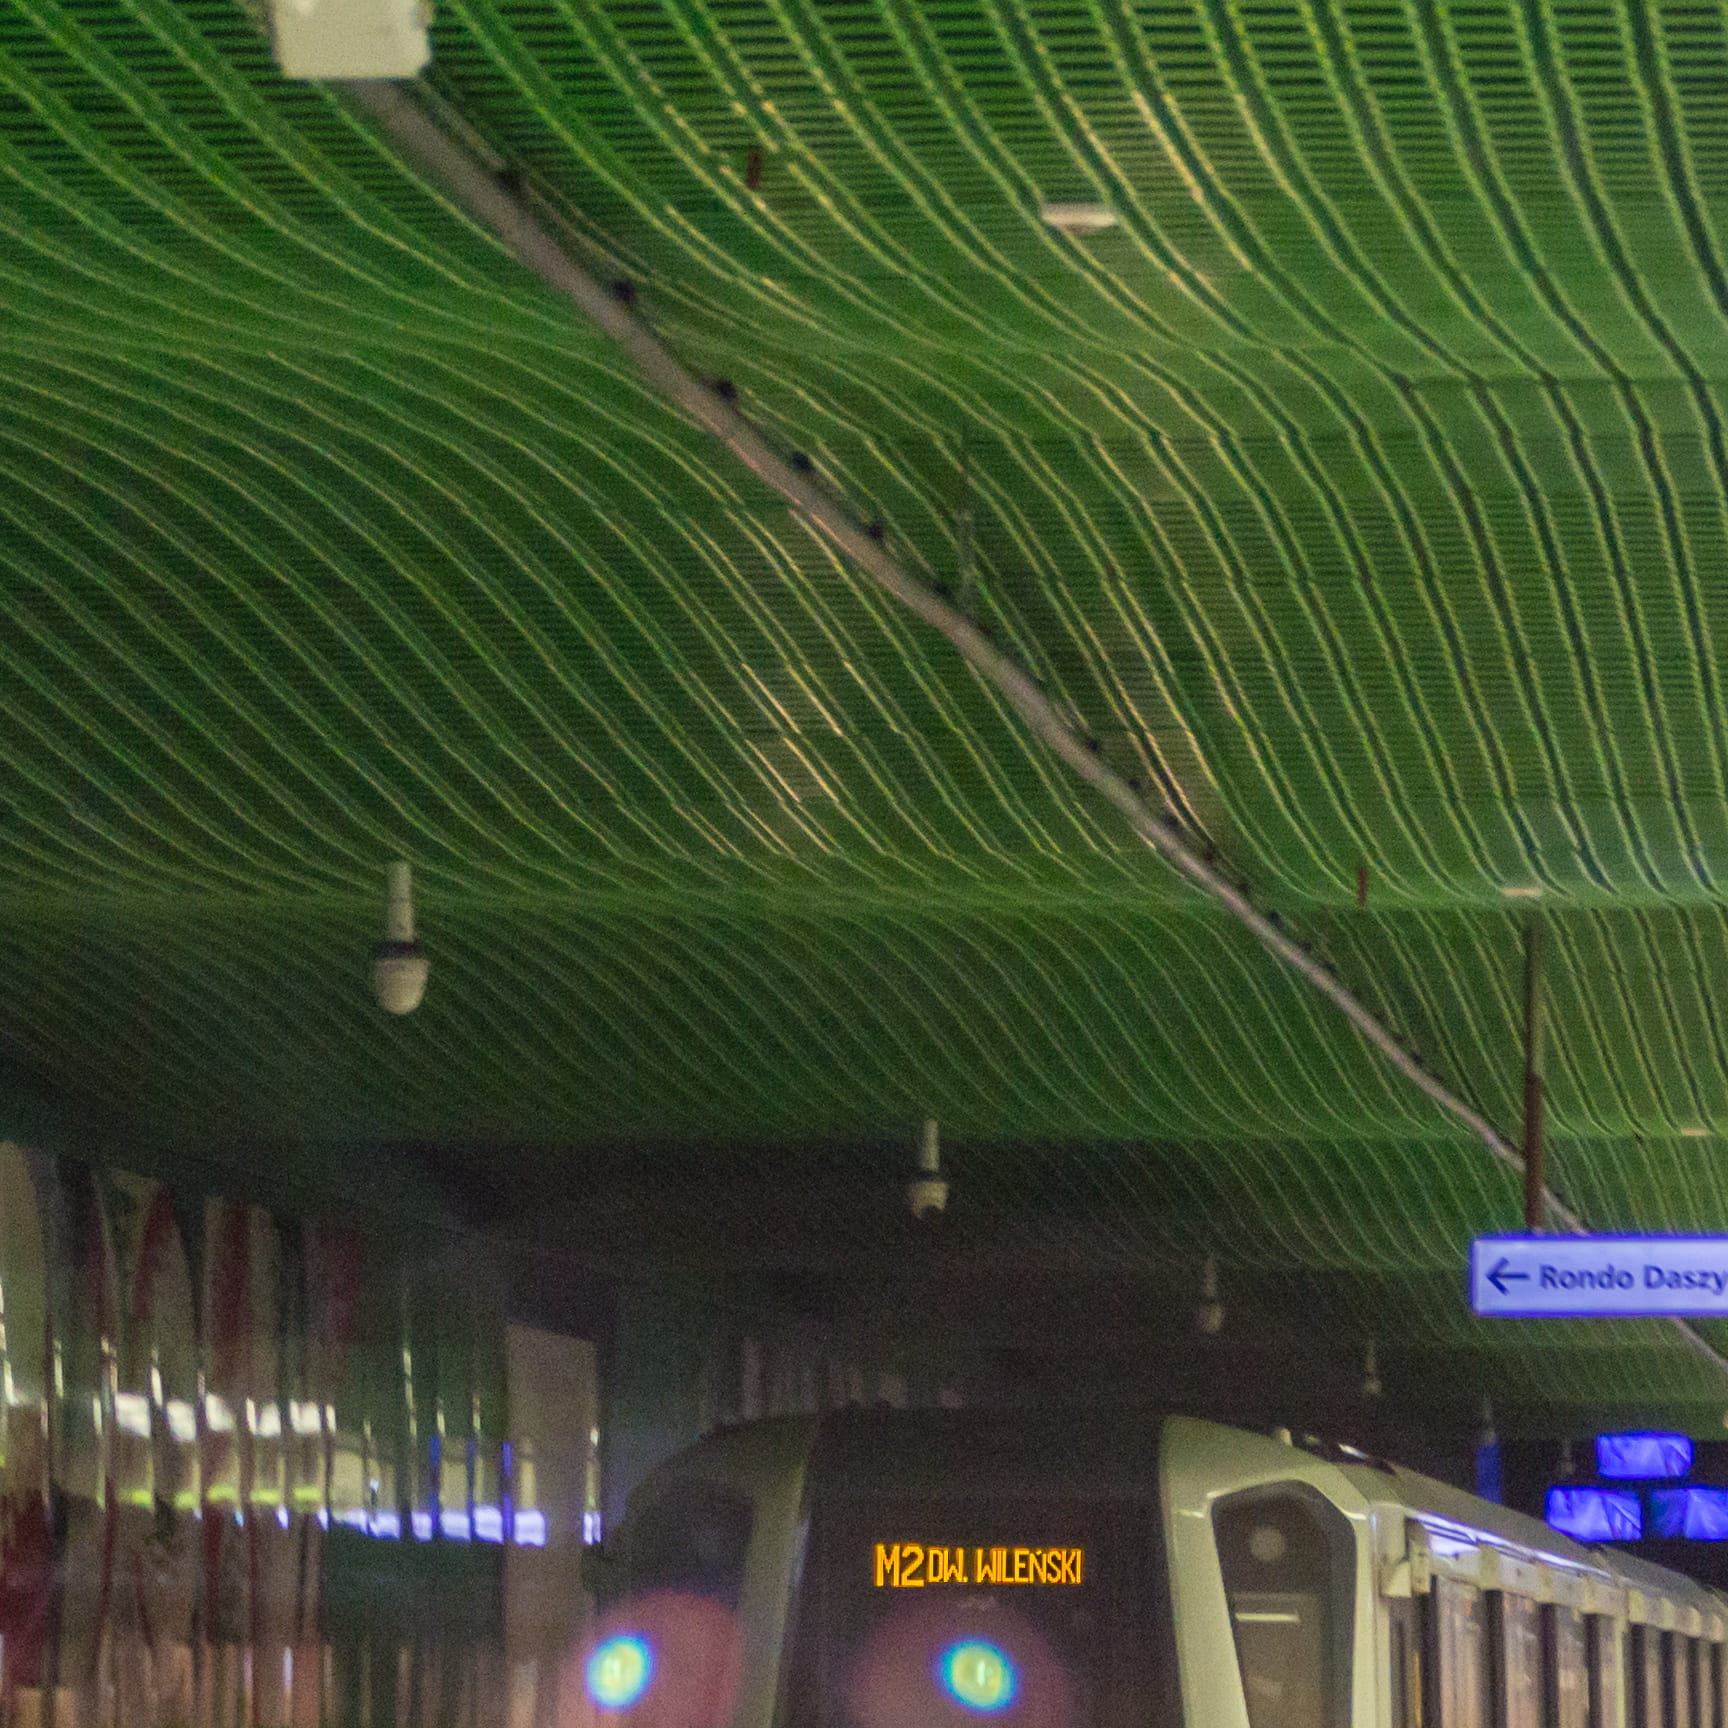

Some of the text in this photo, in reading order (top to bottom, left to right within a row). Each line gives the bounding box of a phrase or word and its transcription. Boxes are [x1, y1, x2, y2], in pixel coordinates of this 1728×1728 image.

[1539, 1262, 1635, 1290] Rondo
[874, 1543, 1085, 1588] M2 DW. WILEŃSKI
